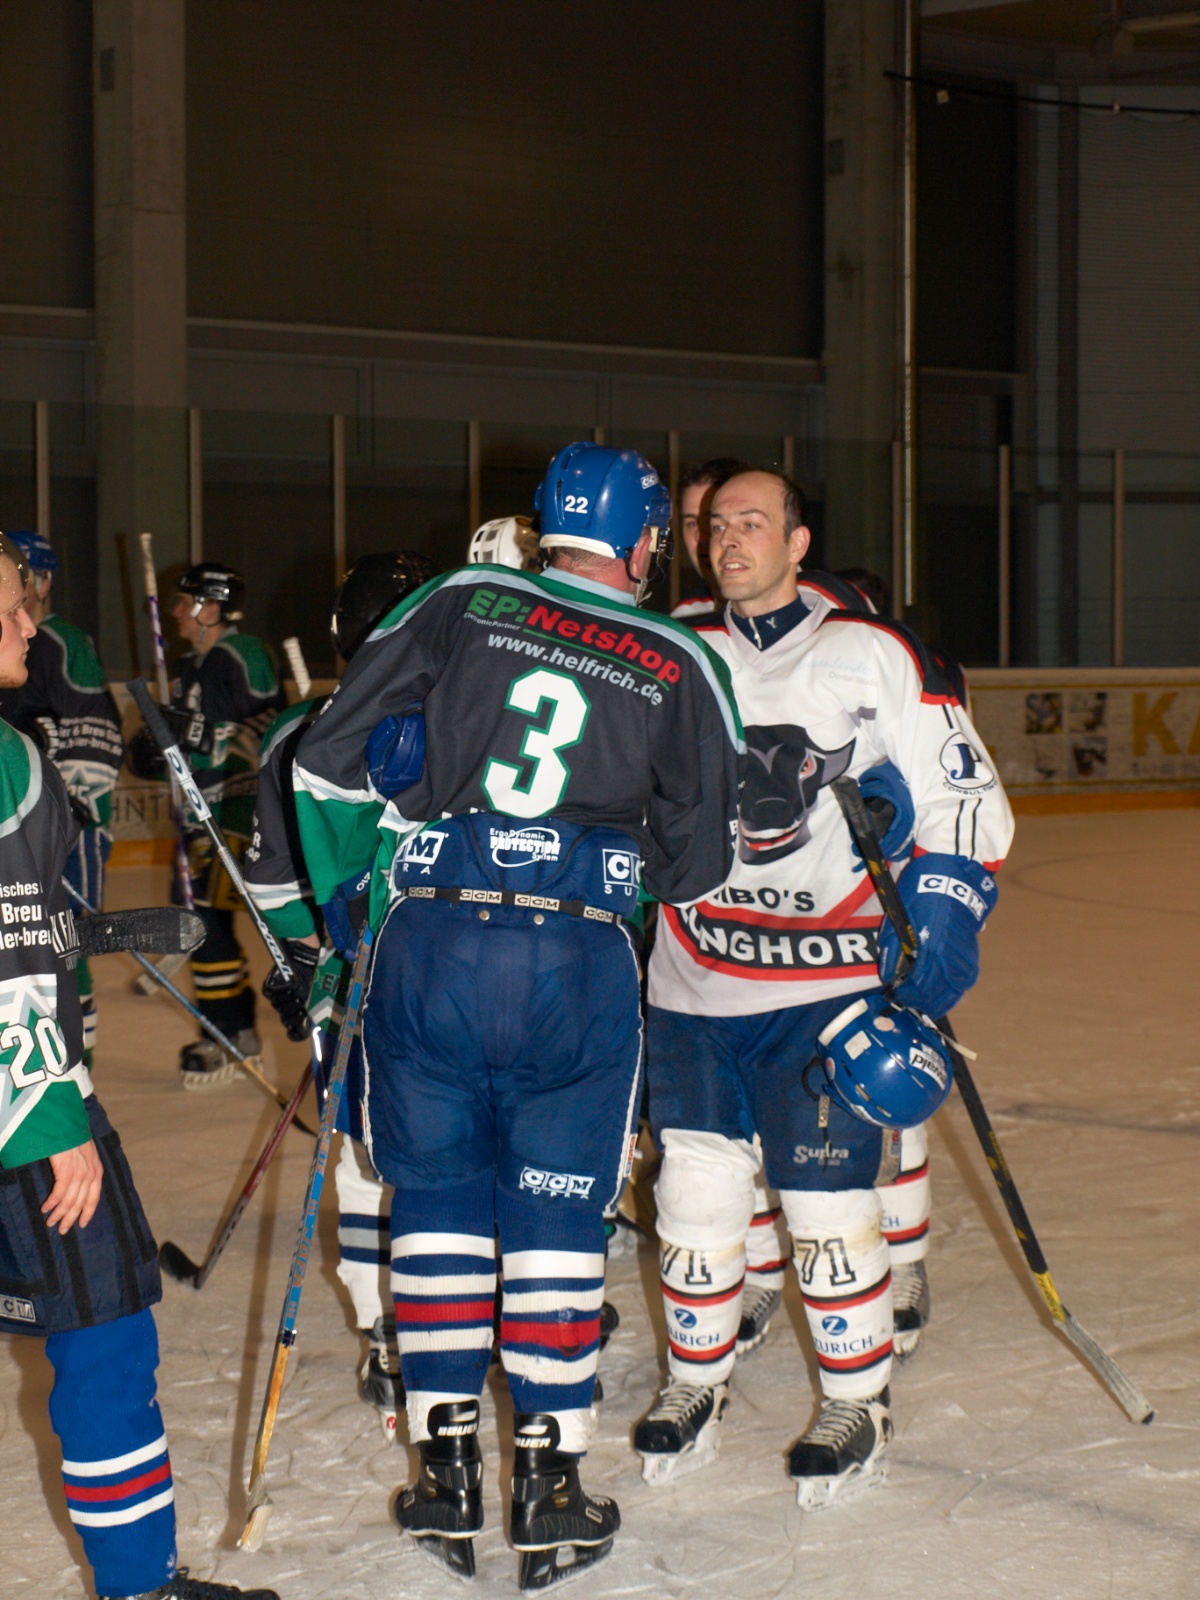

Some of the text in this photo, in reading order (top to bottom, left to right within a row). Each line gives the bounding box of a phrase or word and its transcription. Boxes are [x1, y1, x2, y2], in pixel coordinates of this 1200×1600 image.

[564, 495, 589, 514] 22
[487, 633, 663, 706] www.helfrich.de
[480, 665, 592, 819] 3
[489, 835, 561, 856] PROTECTION
[460, 890, 502, 902] CCM
[516, 894, 559, 910] CCM
[919, 875, 987, 920] CCM
[1, 902, 42, 924] Breu
[585, 907, 614, 922] CCM
[0, 1015, 68, 1089] 20
[521, 1168, 594, 1195] CCM
[796, 1237, 857, 1286] 71
